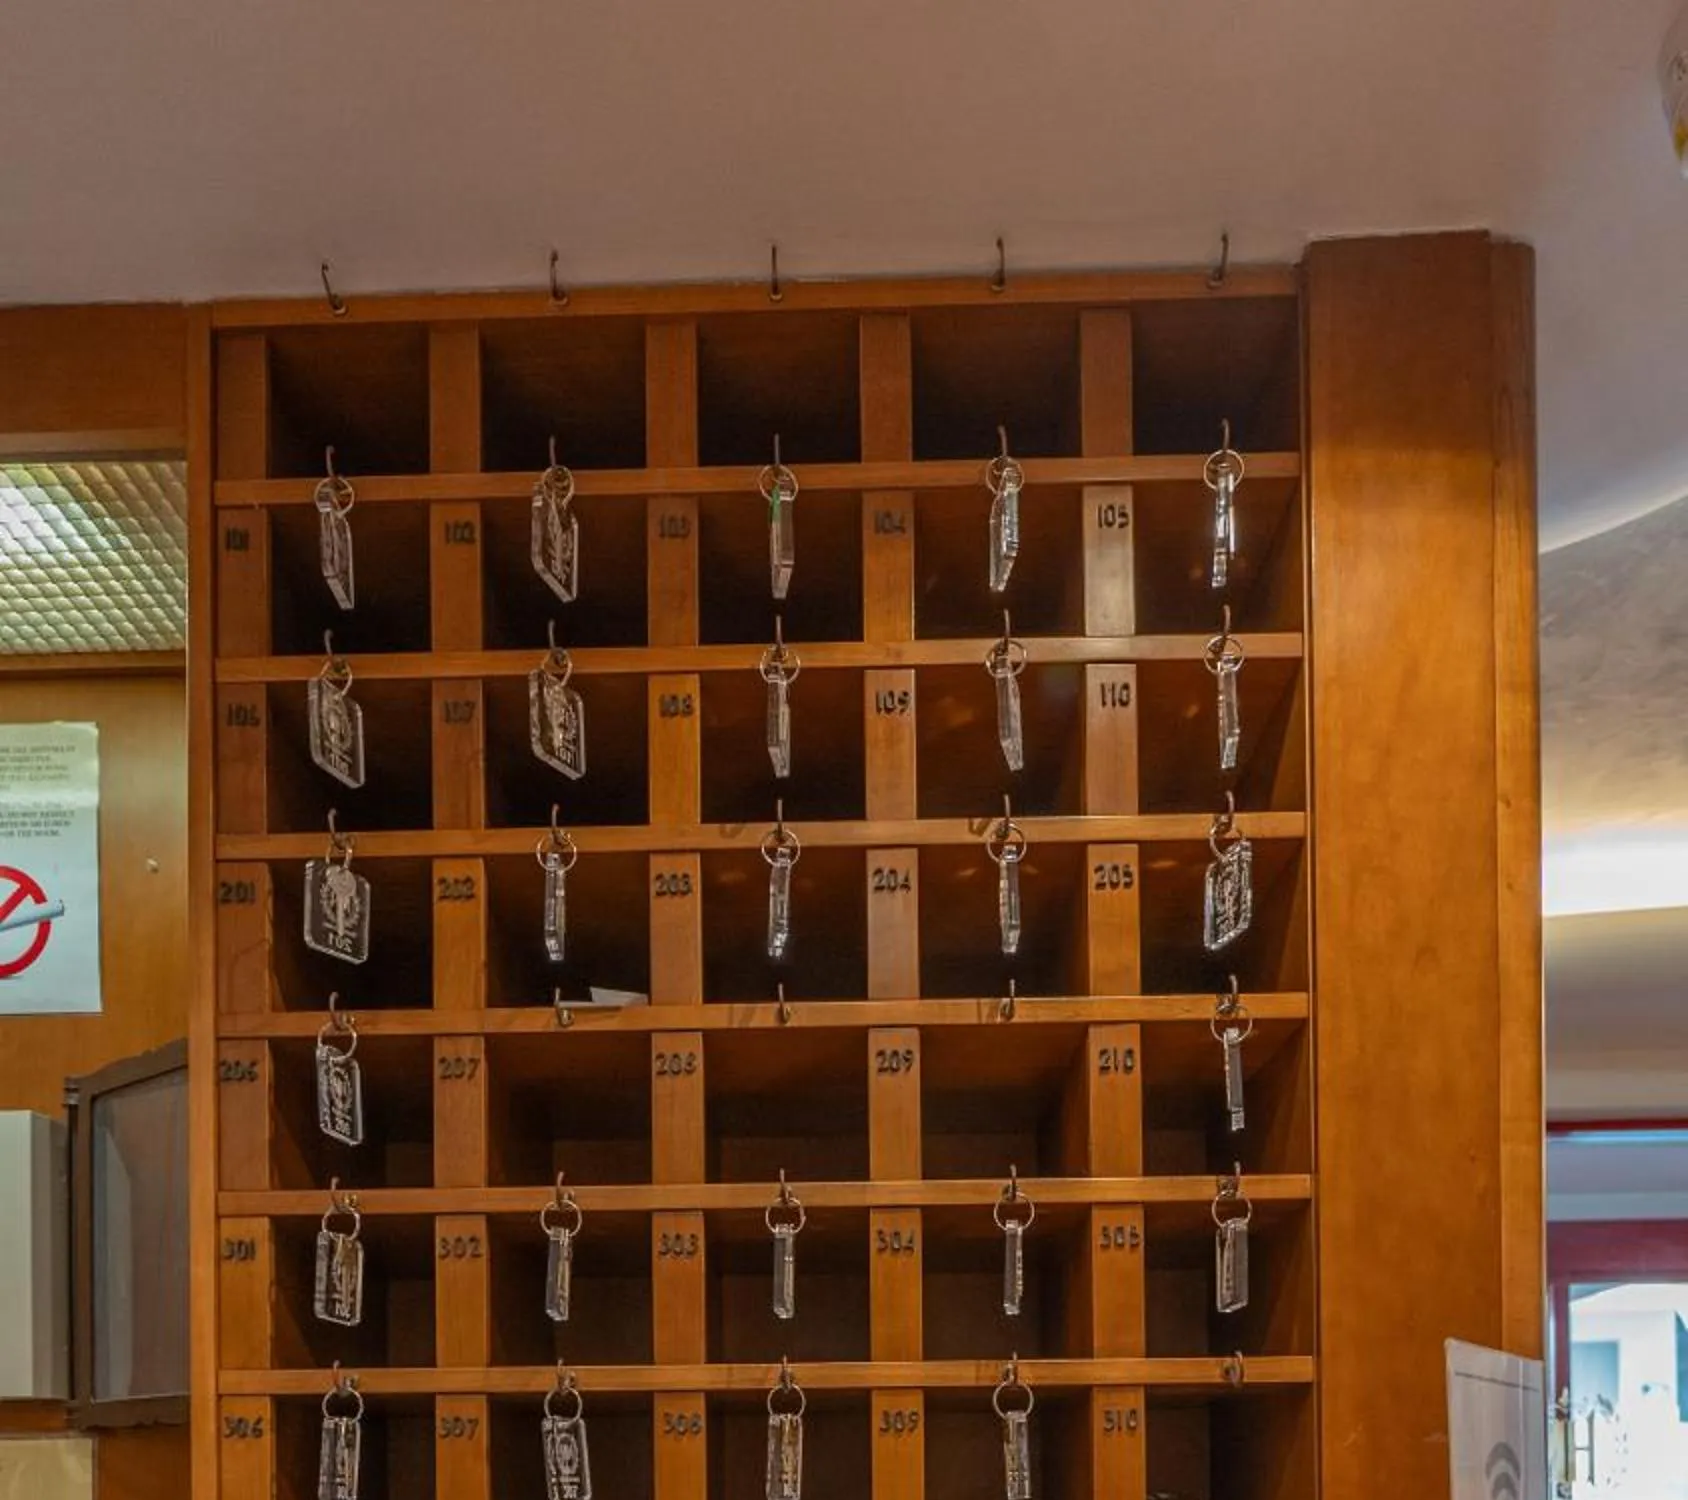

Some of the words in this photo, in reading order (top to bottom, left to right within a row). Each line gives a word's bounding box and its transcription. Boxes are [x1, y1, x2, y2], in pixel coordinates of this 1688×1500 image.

[875, 510, 906, 534] 104
[1098, 504, 1129, 529] 105
[225, 529, 249, 552] 101
[446, 521, 475, 545] 102
[659, 694, 693, 718] 108
[876, 691, 910, 715] 109
[1101, 683, 1130, 708] 110
[446, 700, 475, 724] 107
[655, 874, 692, 897] 203
[873, 869, 911, 894] 204
[1094, 865, 1134, 890] 205
[219, 881, 254, 905] 201
[438, 878, 475, 902] 202
[439, 1057, 481, 1081] 207
[656, 1052, 697, 1076] 208
[876, 1050, 913, 1074] 209
[1099, 1048, 1134, 1075] 210
[439, 1236, 483, 1259] 302
[658, 1234, 698, 1257] 303
[877, 1230, 915, 1254] 304
[1100, 1225, 1140, 1250] 305
[223, 1239, 255, 1261] 301
[224, 1417, 263, 1438] 306
[440, 1417, 478, 1440] 307
[880, 1410, 919, 1434] 309
[1103, 1410, 1137, 1432] 310
